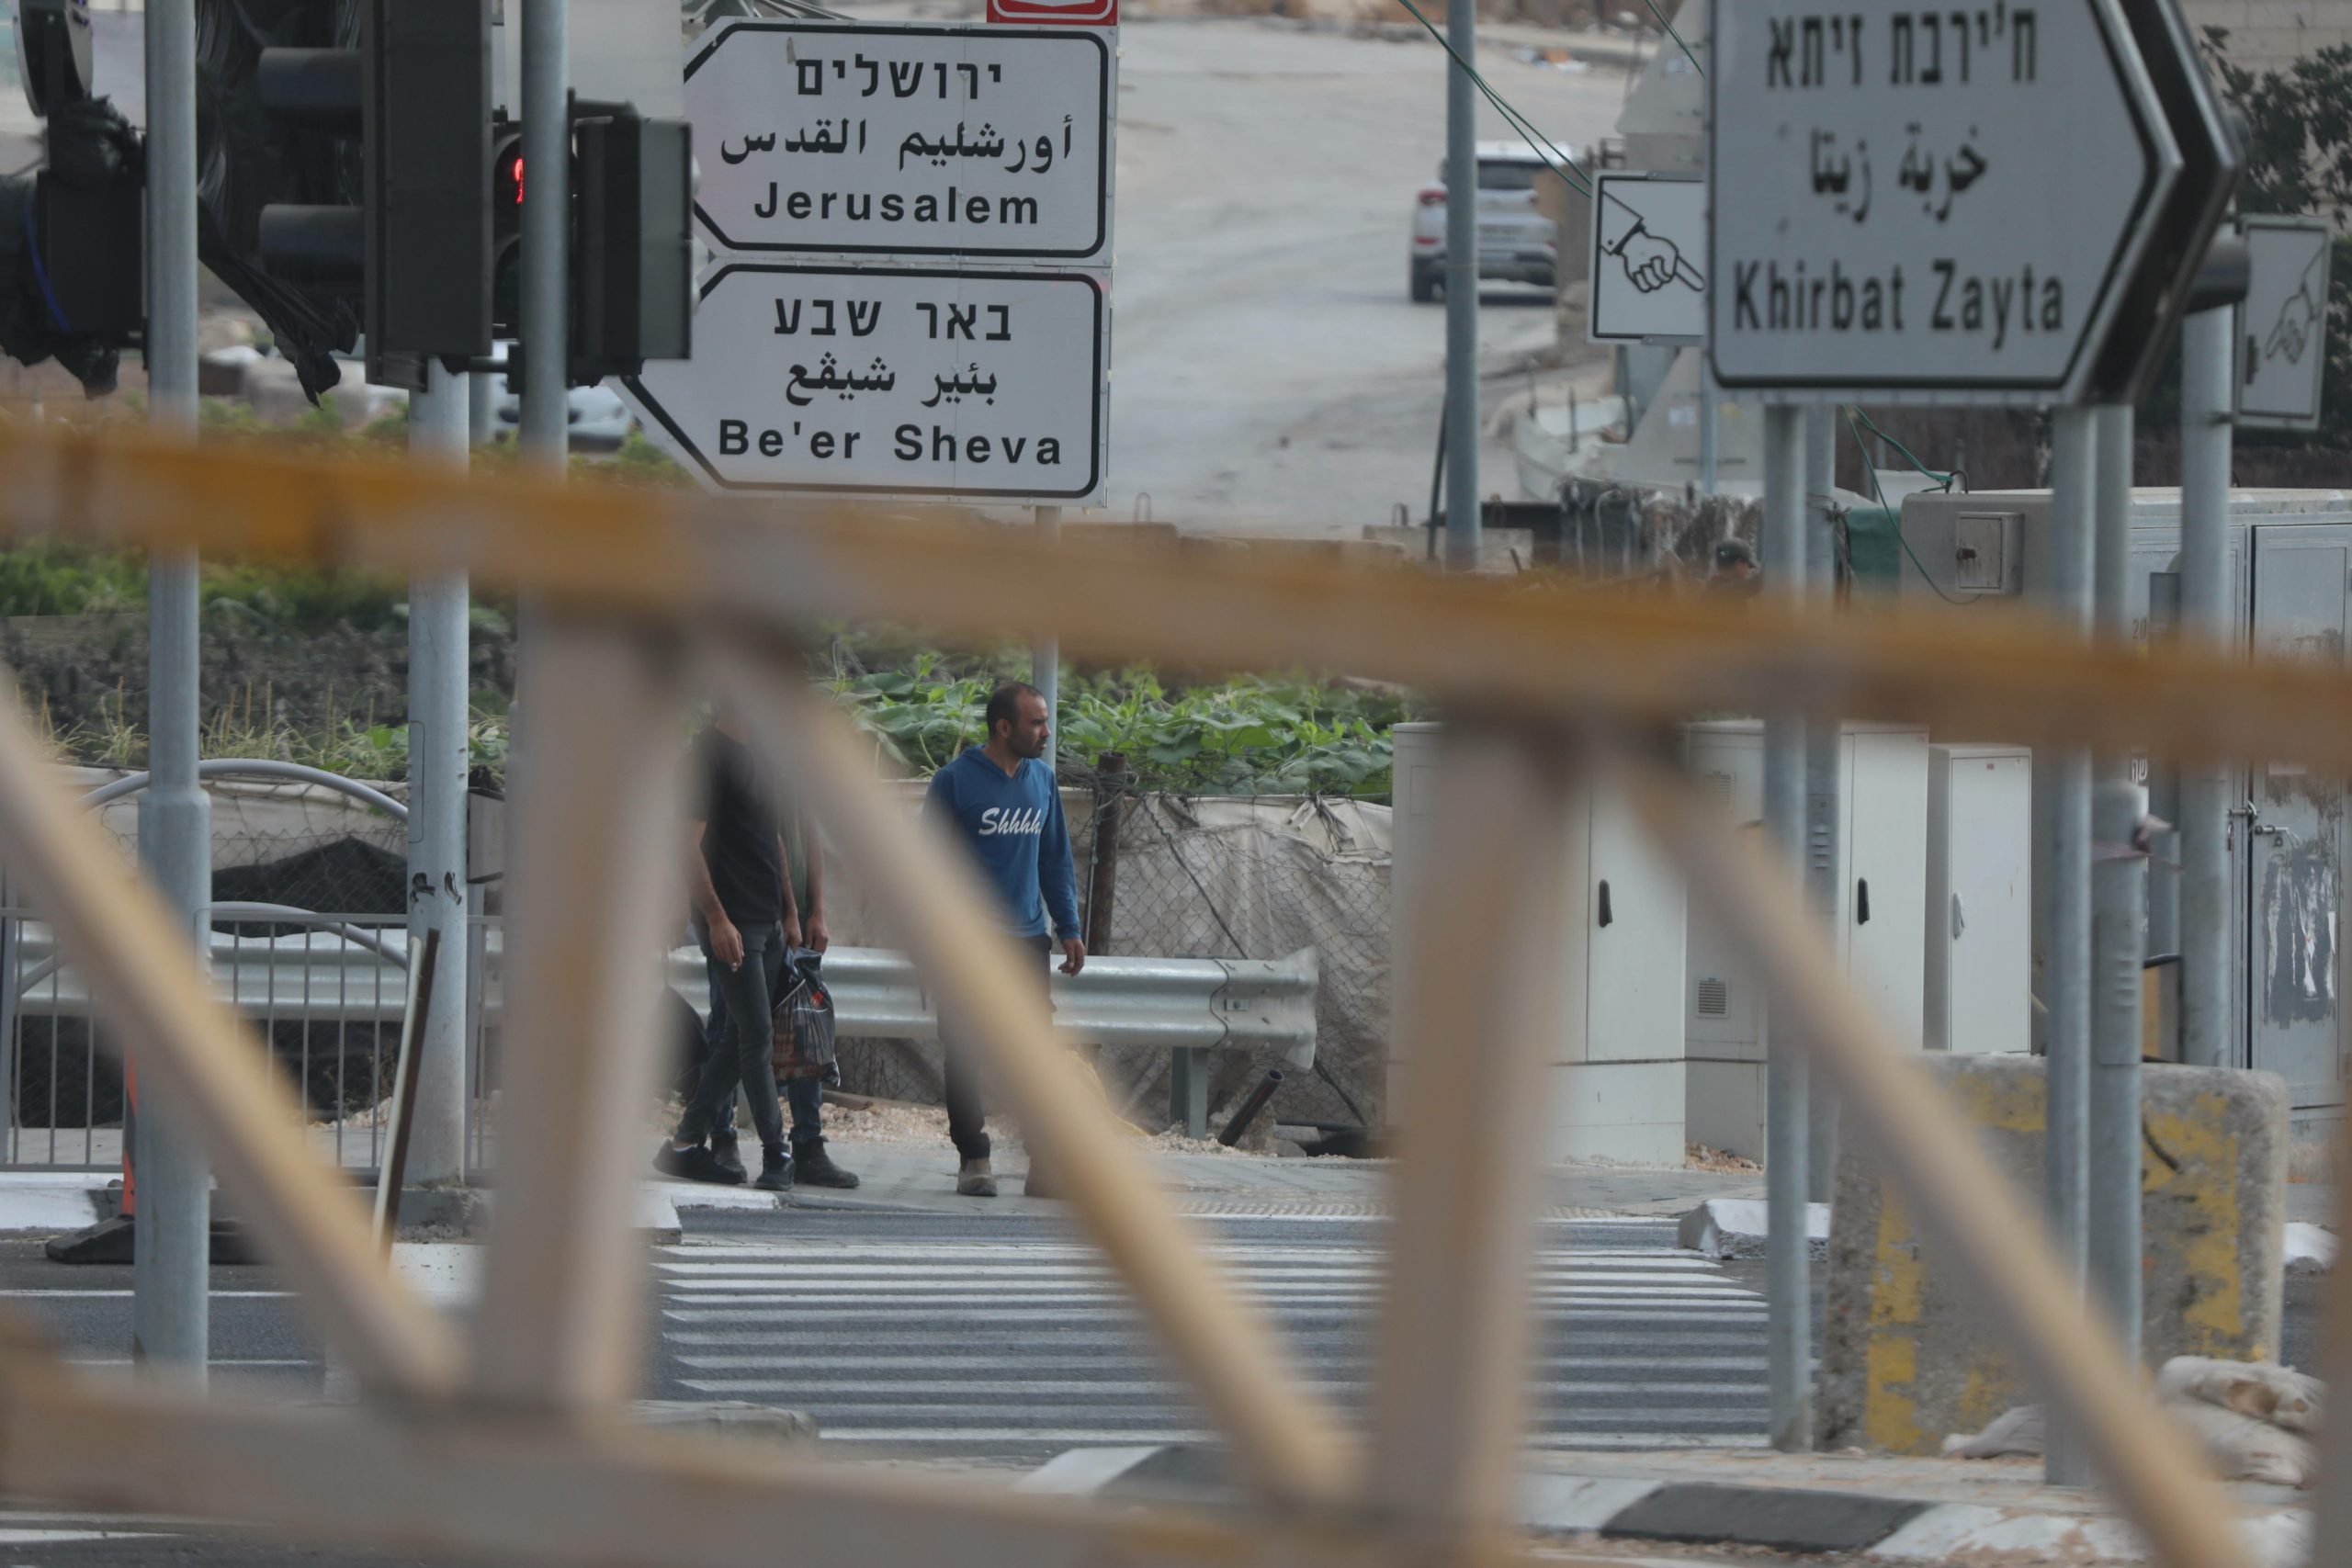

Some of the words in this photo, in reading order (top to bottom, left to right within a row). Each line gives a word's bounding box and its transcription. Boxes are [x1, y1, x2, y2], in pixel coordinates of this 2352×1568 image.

[1768, 15, 1863, 87] זיתא
[795, 53, 1001, 99] ירושלים
[721, 118, 865, 164] القدس
[899, 115, 1072, 174] أورشليم
[1810, 129, 1871, 224] زيتا
[1899, 123, 1986, 223] خربة
[754, 182, 1038, 224] Jerusalem
[775, 299, 882, 336] שבע
[916, 302, 1012, 341] באר
[1734, 260, 1905, 333] Khirbat
[1929, 259, 2064, 352] Zayta
[786, 352, 896, 406] شيڤع
[922, 363, 998, 407] بئير
[719, 420, 861, 459] Be'er
[894, 424, 1061, 464] Sheva
